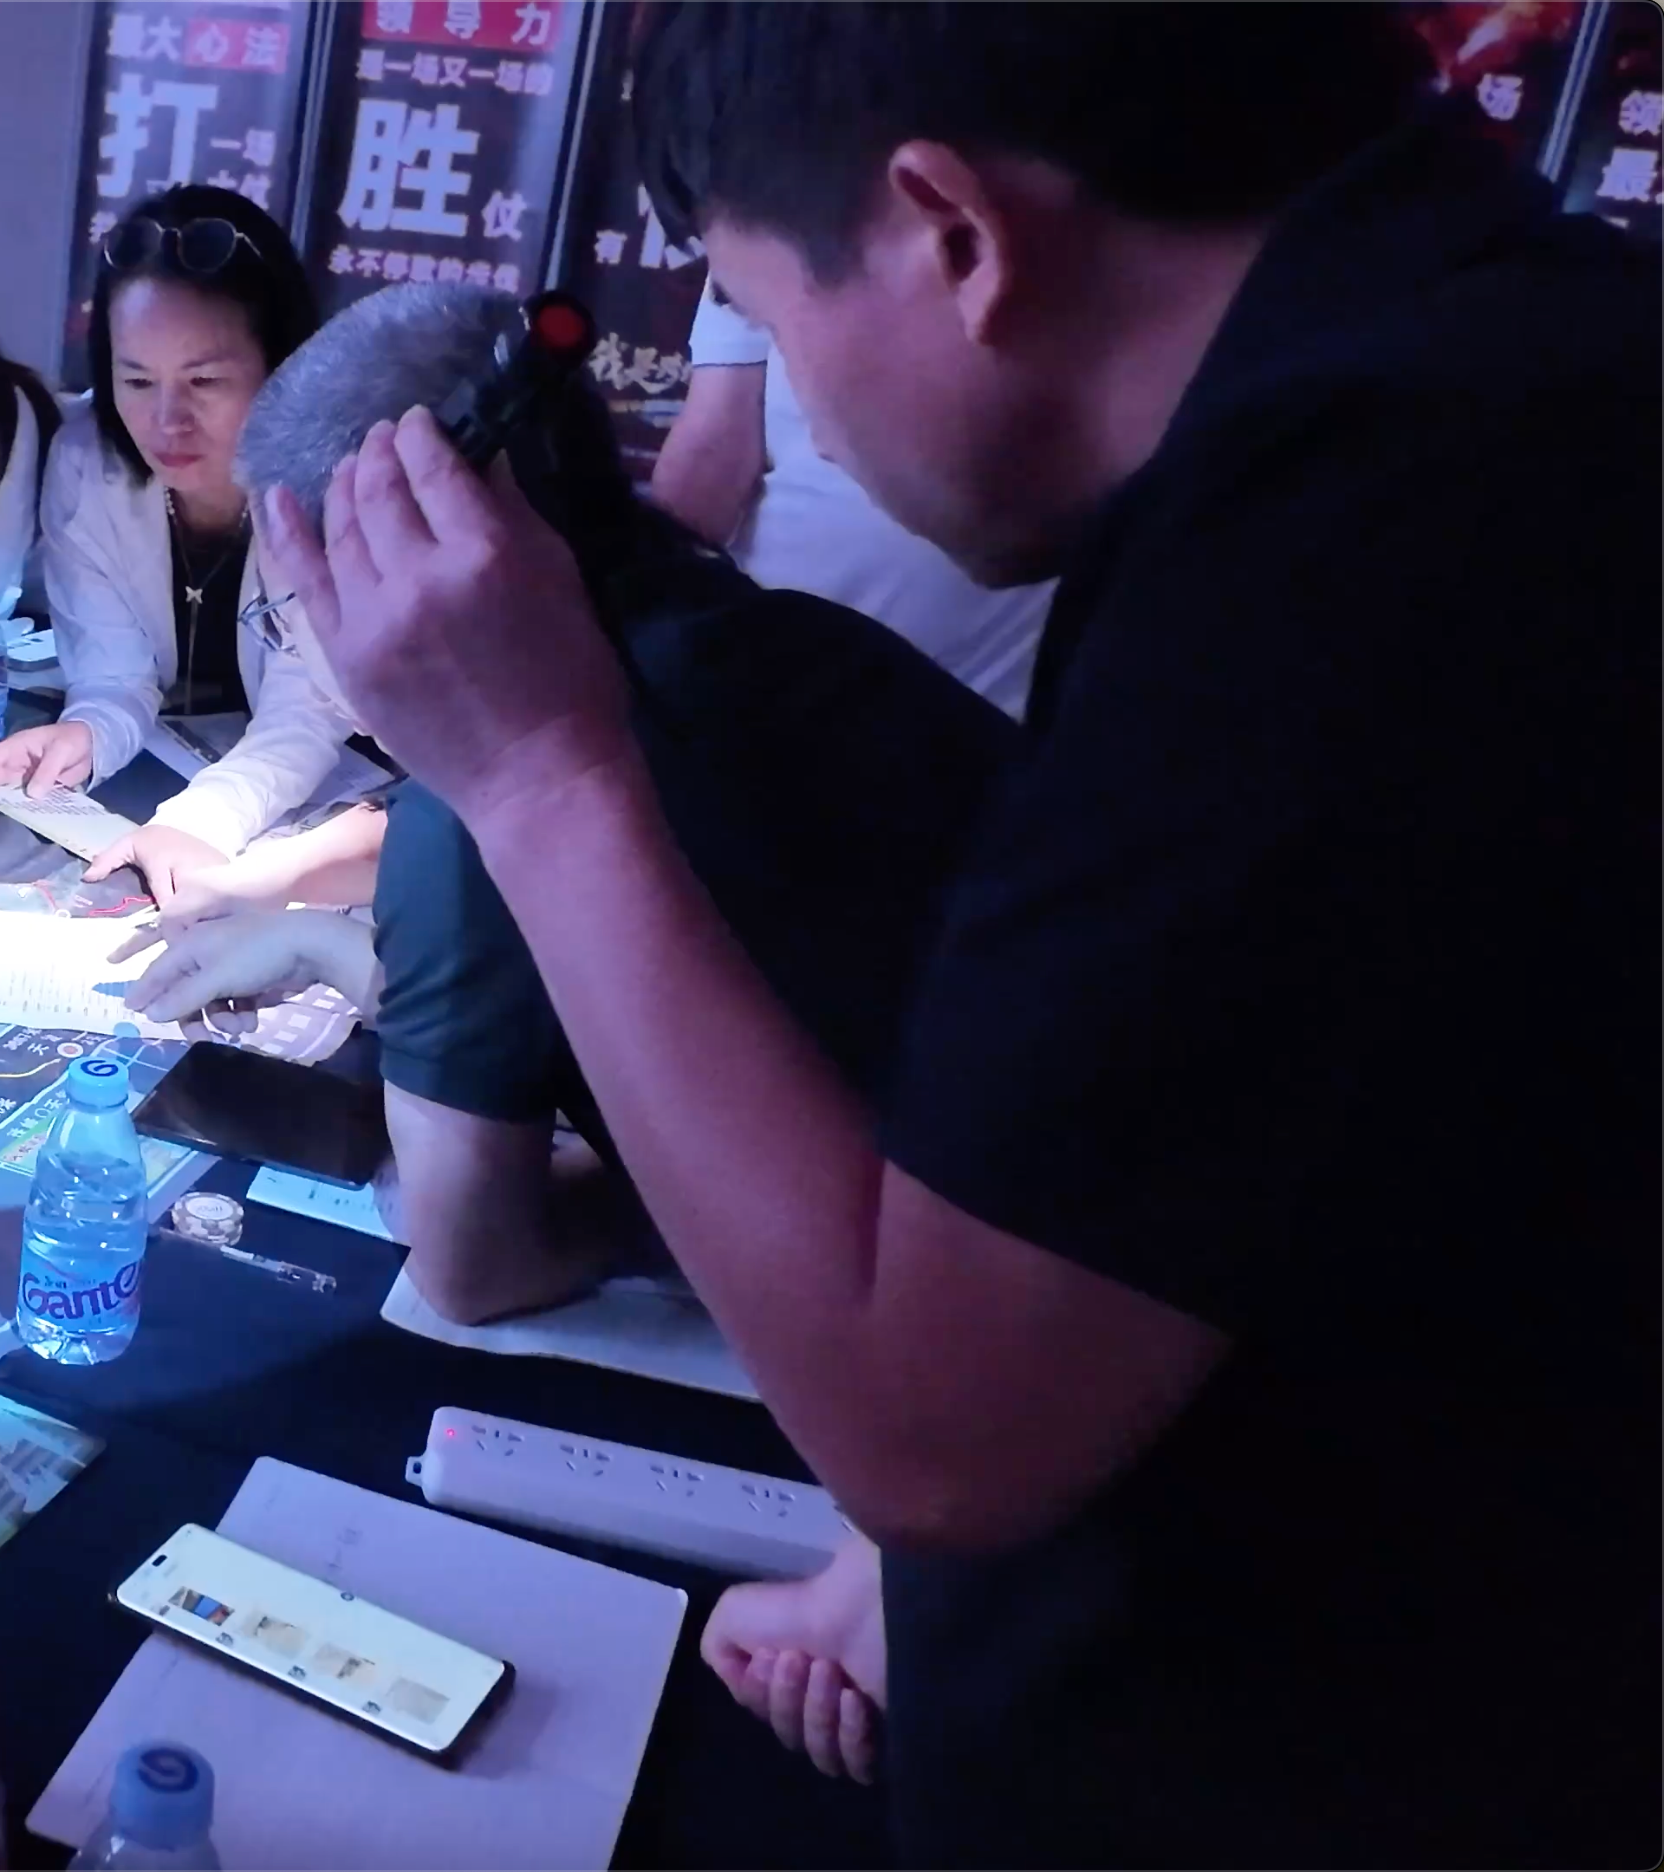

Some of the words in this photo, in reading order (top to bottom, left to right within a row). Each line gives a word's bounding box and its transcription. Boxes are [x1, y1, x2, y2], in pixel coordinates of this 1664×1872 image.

[97, 73, 218, 197] 打
[338, 98, 482, 237] 胜
[482, 190, 527, 241] 仗
